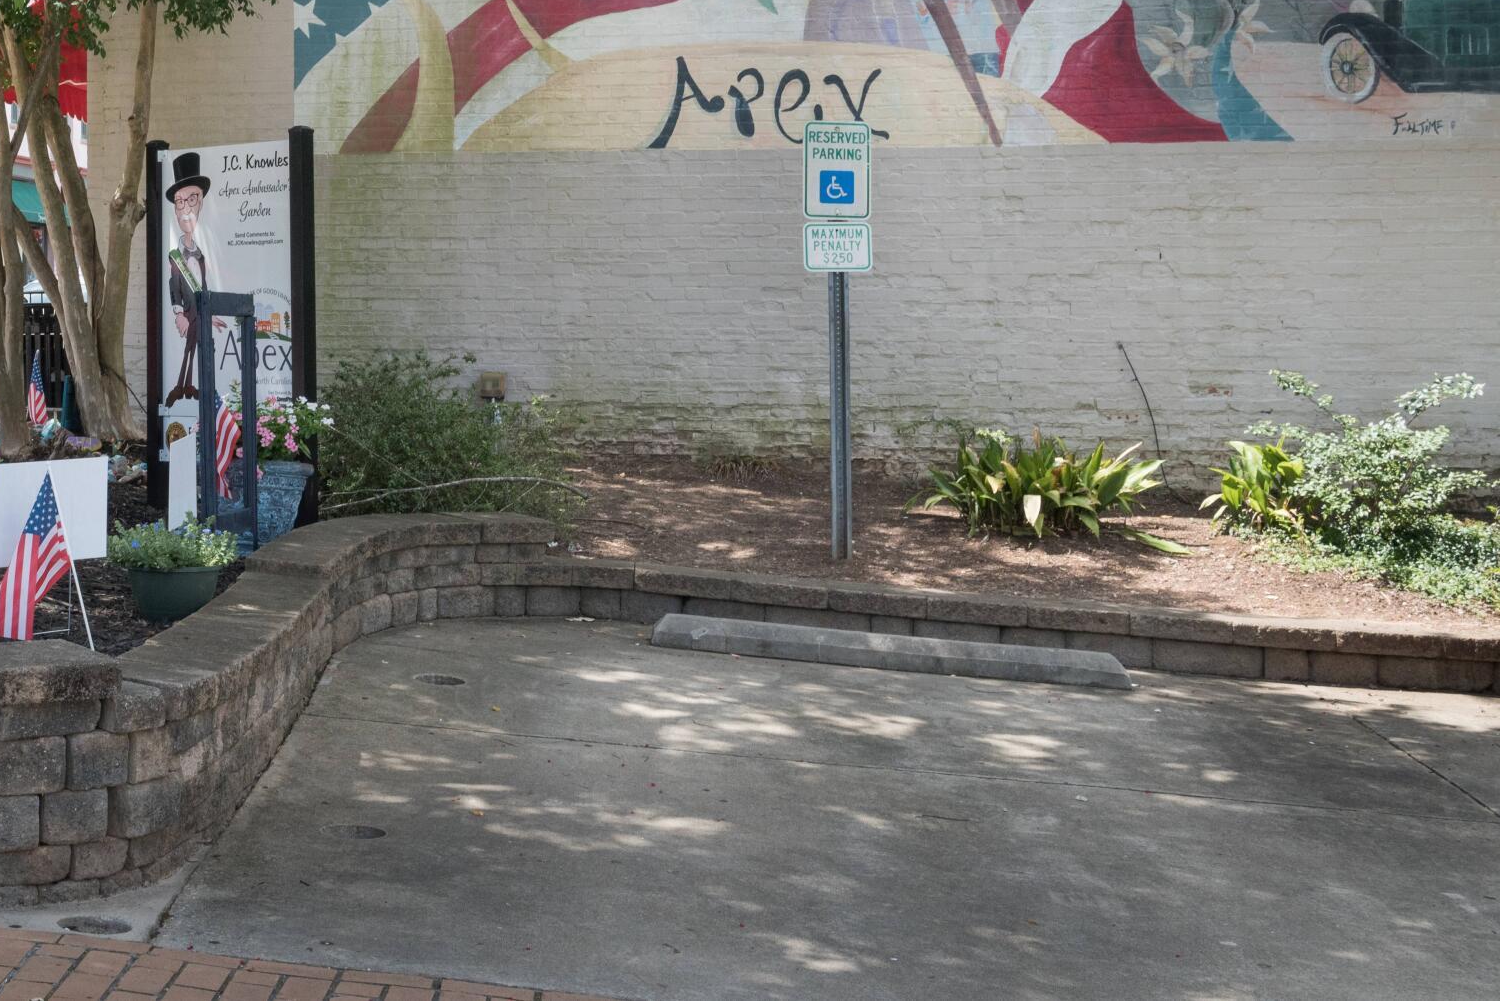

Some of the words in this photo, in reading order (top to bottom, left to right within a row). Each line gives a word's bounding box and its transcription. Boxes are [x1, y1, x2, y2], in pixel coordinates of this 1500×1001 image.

[808, 131, 866, 145] RESERVED
[812, 147, 862, 161] PARKING
[221, 154, 242, 173] J.C.
[246, 150, 289, 170] Knowles
[219, 180, 240, 199] Apex
[238, 200, 271, 223] Garden
[811, 228, 863, 239] MAXIMUM
[813, 240, 861, 252] PENALTY
[823, 252, 853, 264] $250
[219, 329, 292, 372] Aex
